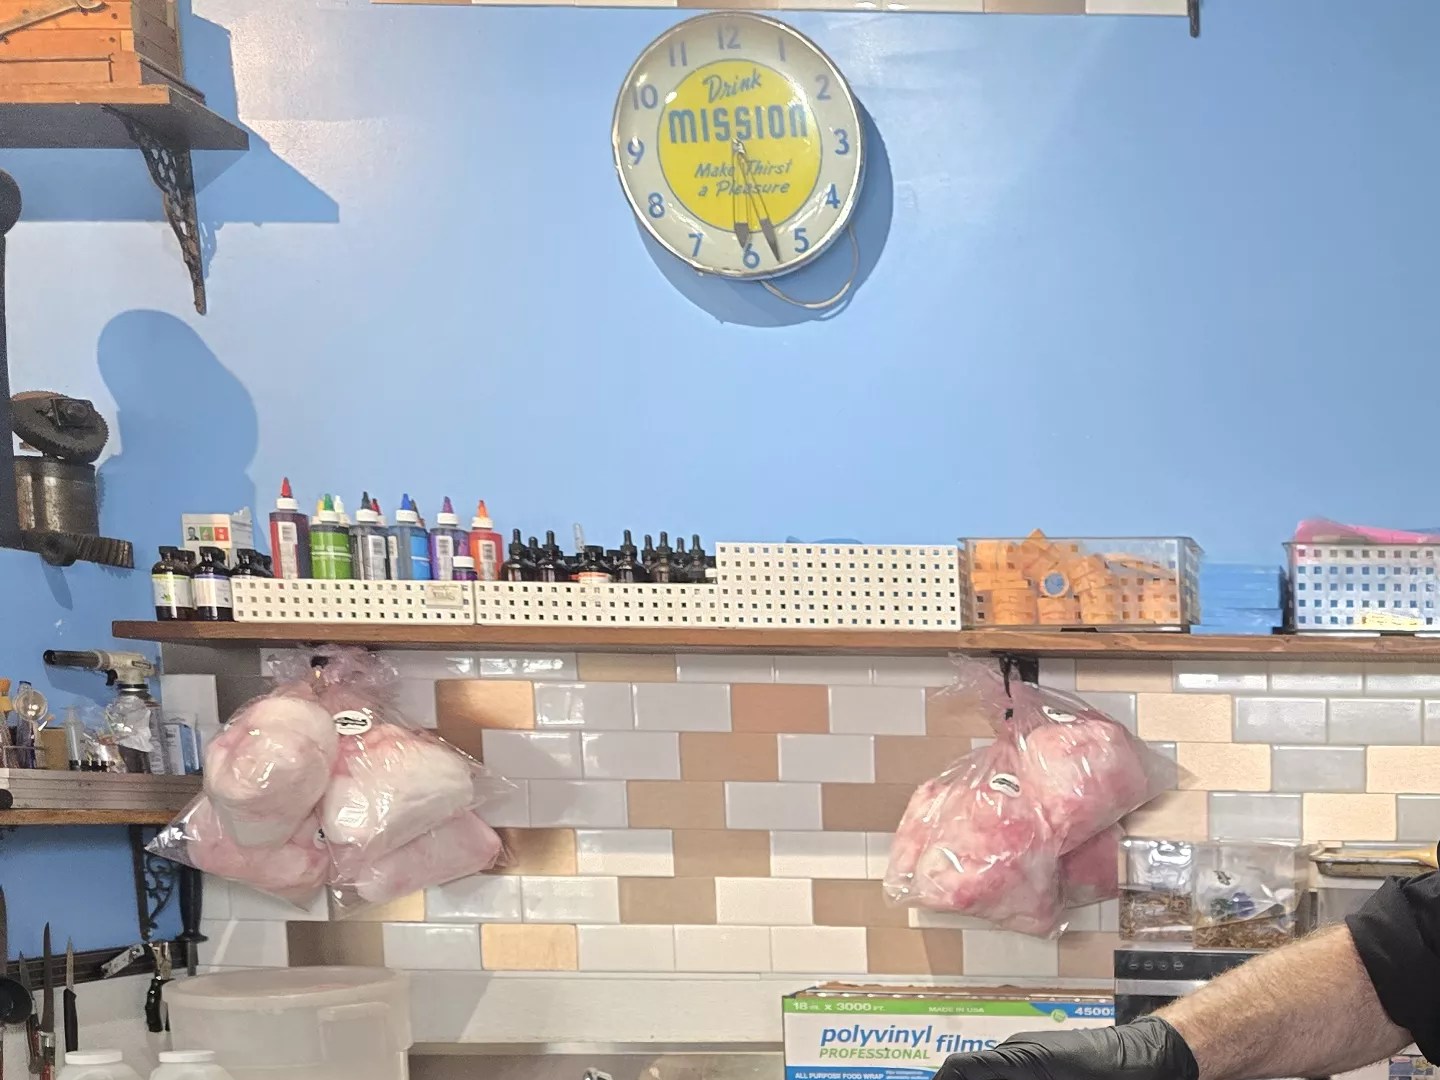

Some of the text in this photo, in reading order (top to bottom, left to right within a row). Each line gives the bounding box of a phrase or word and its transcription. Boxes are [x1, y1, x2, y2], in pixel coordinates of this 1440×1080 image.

[717, 26, 741, 50] 12
[777, 36, 786, 62] 1
[668, 41, 688, 67] 11
[632, 83, 659, 111] 10
[702, 67, 762, 104] Drink
[815, 74, 831, 101] 2
[668, 104, 808, 144] MISSION
[627, 139, 645, 166] 9
[833, 128, 850, 155] 3
[694, 158, 793, 178] Make Thirst
[697, 180, 791, 197] a Pleasure
[824, 183, 841, 210] 4
[648, 192, 666, 219] 8
[688, 232, 704, 258] 7
[793, 227, 810, 254] 5
[742, 242, 761, 270] 6
[793, 1002, 808, 1011] 18
[836, 1002, 872, 1012] 3000
[820, 1024, 996, 1053] polyvinyl films
[819, 1047, 931, 1060] PROFESSIONAL
